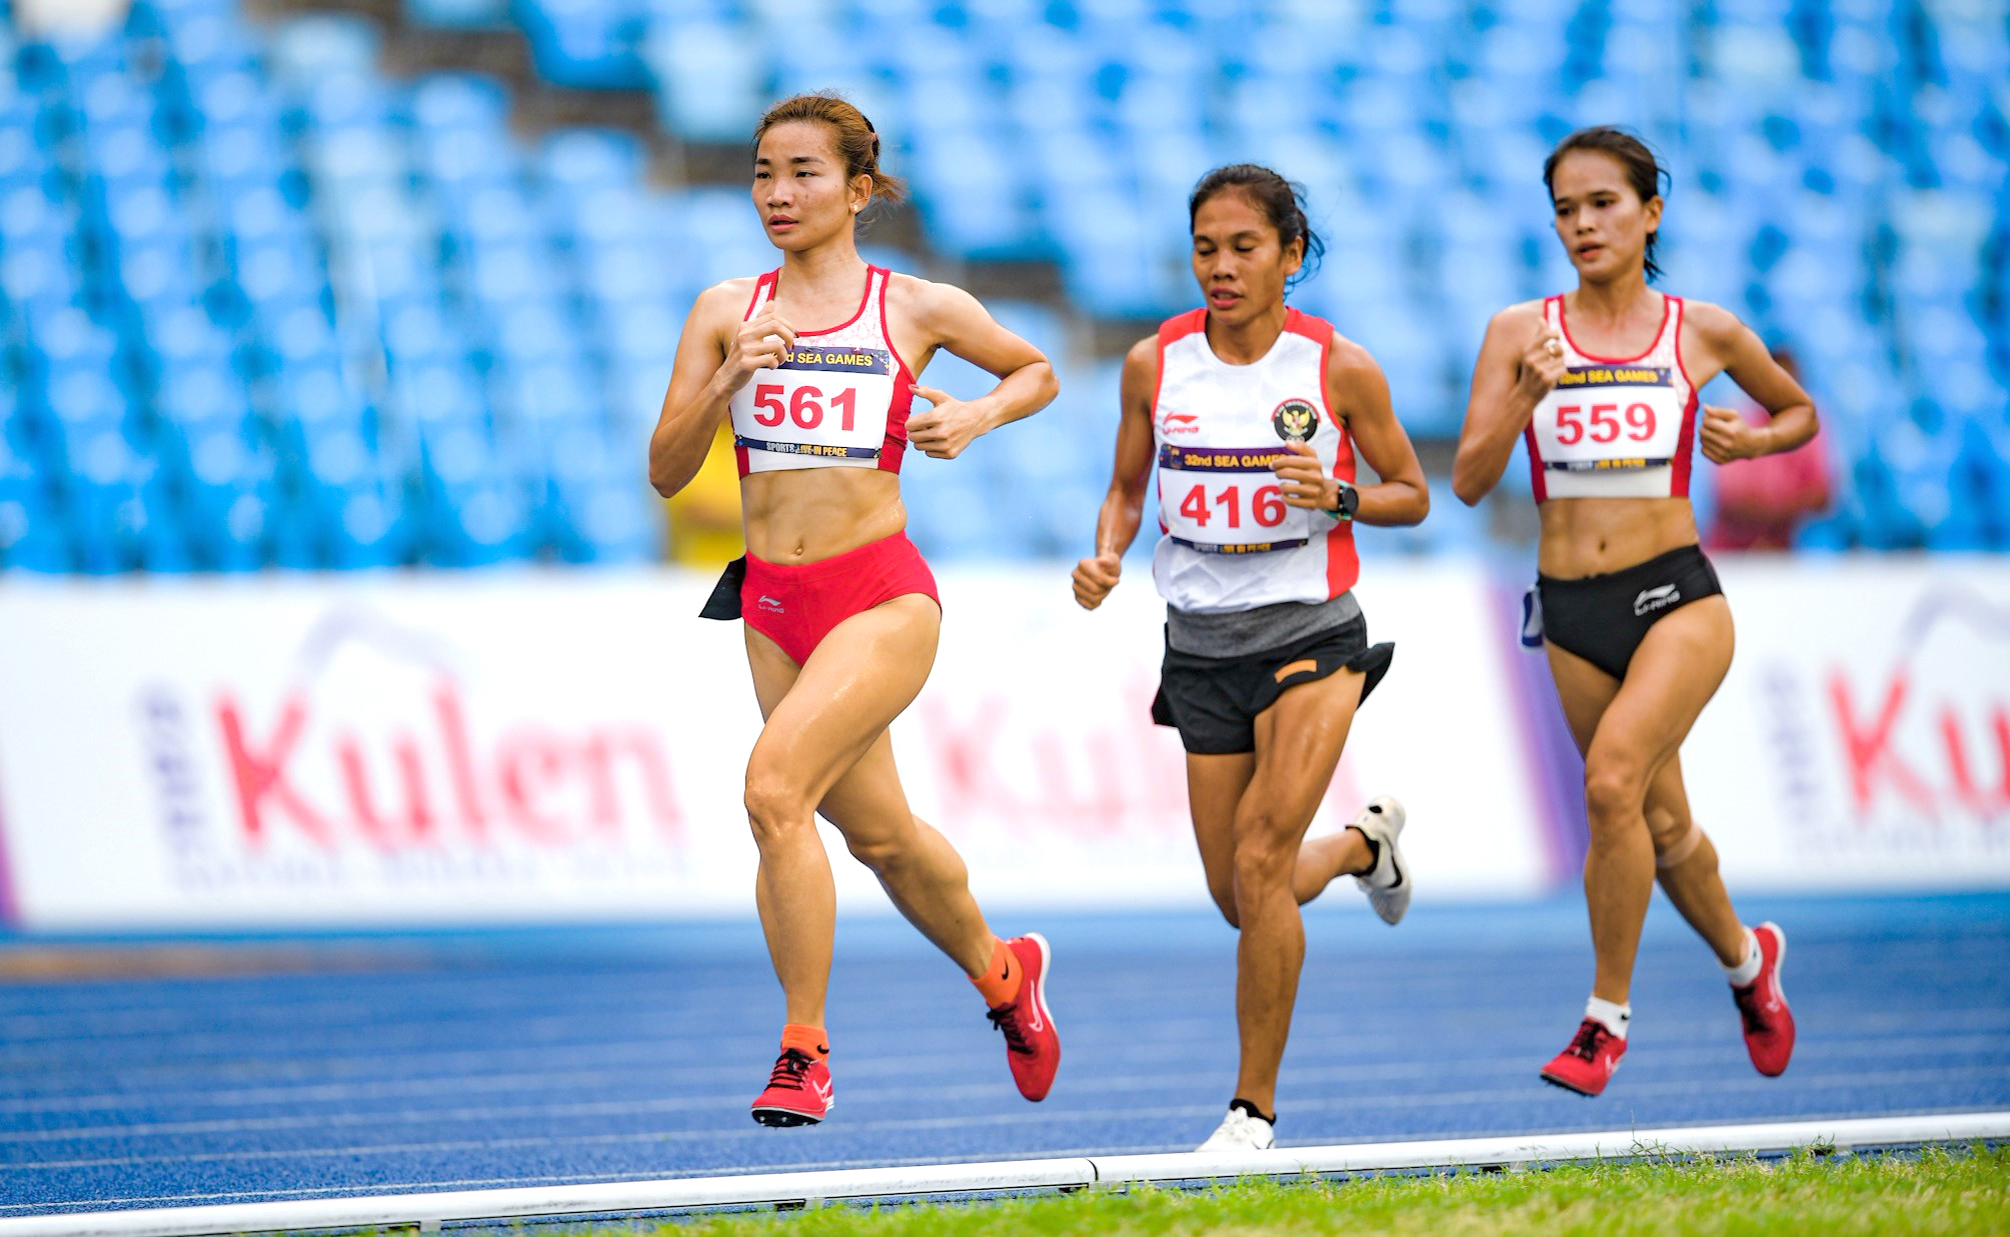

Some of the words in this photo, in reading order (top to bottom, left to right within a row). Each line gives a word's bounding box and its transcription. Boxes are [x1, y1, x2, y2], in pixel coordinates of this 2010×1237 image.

[797, 352, 822, 364] SEA
[825, 354, 873, 367] GAMES
[1587, 369, 1614, 383] SEA
[1614, 369, 1659, 383] GAMES
[752, 383, 857, 432] 561
[1556, 403, 1657, 445] 559
[823, 446, 847, 457] PEACE
[1184, 453, 1213, 467] 32nd
[1214, 454, 1240, 468] SEA
[1179, 484, 1287, 529] 416
[212, 670, 692, 852] Kulen
